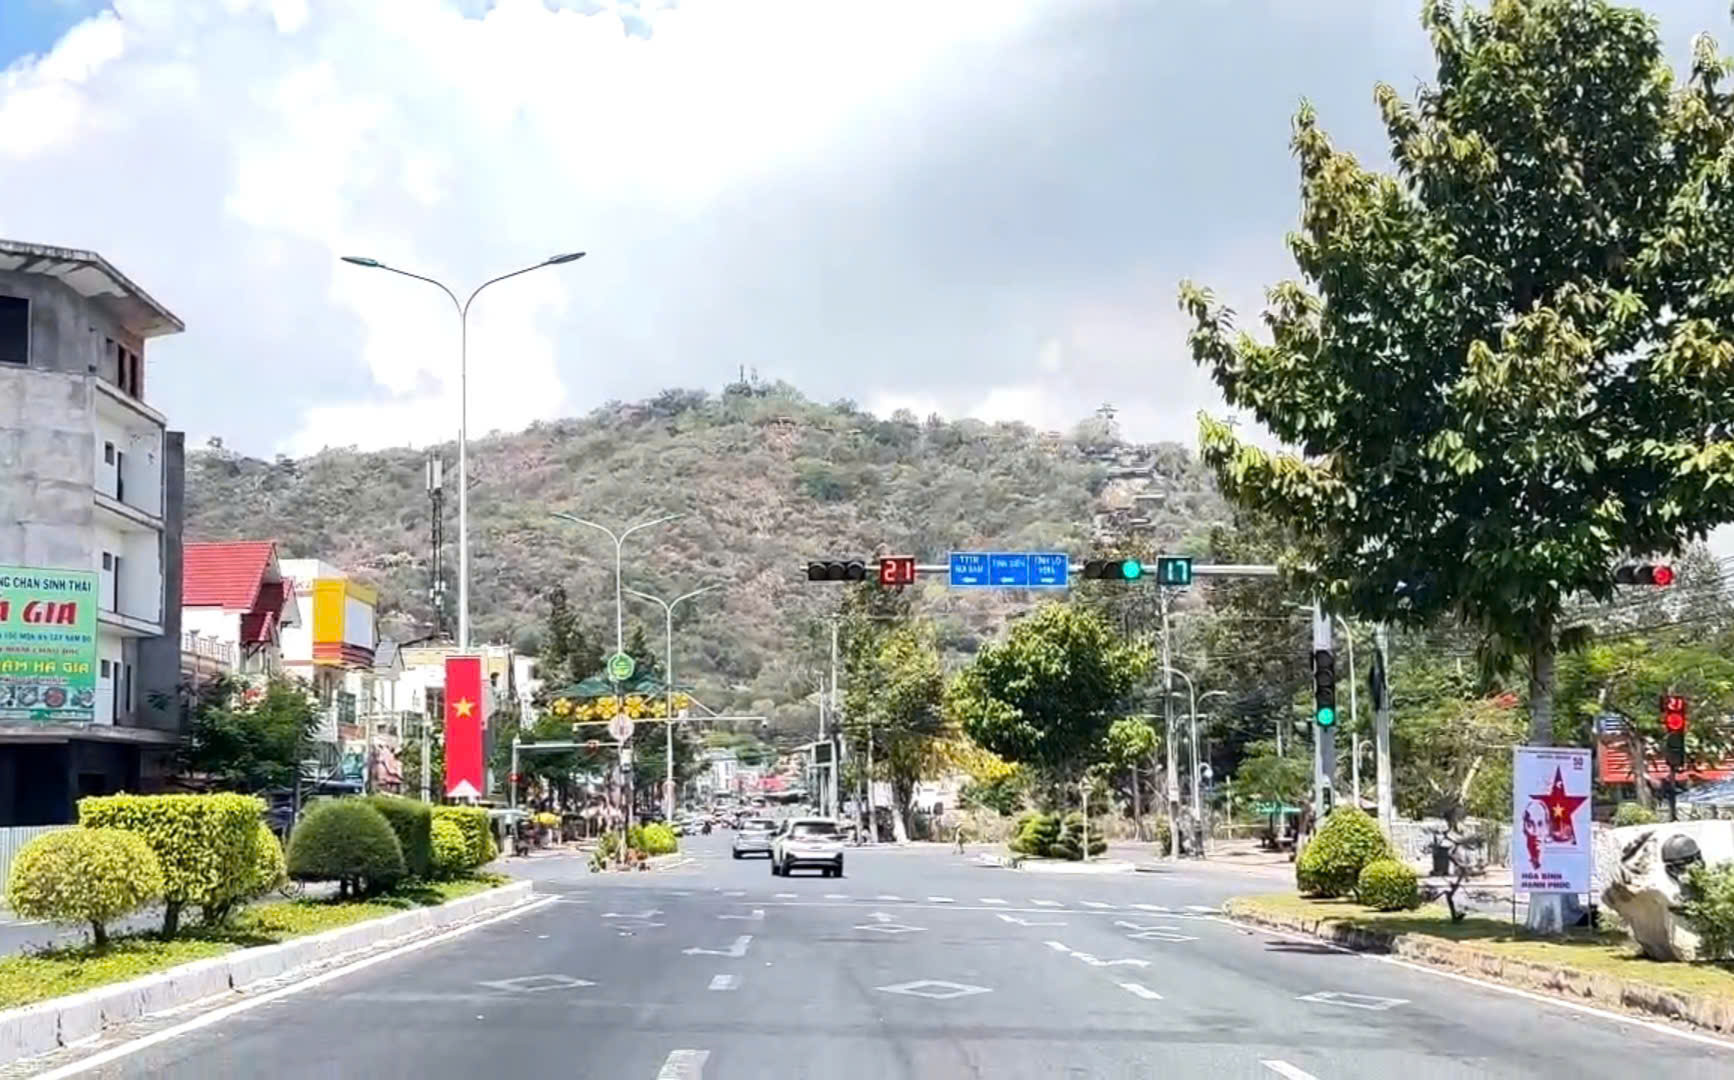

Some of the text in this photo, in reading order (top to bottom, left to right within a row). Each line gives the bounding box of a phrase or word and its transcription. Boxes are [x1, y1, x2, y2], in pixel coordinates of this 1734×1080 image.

[884, 560, 911, 581] 21
[1167, 560, 1188, 582] 17
[43, 579, 65, 591] SINH
[22, 600, 77, 625] GIA
[1667, 697, 1683, 711] 21
